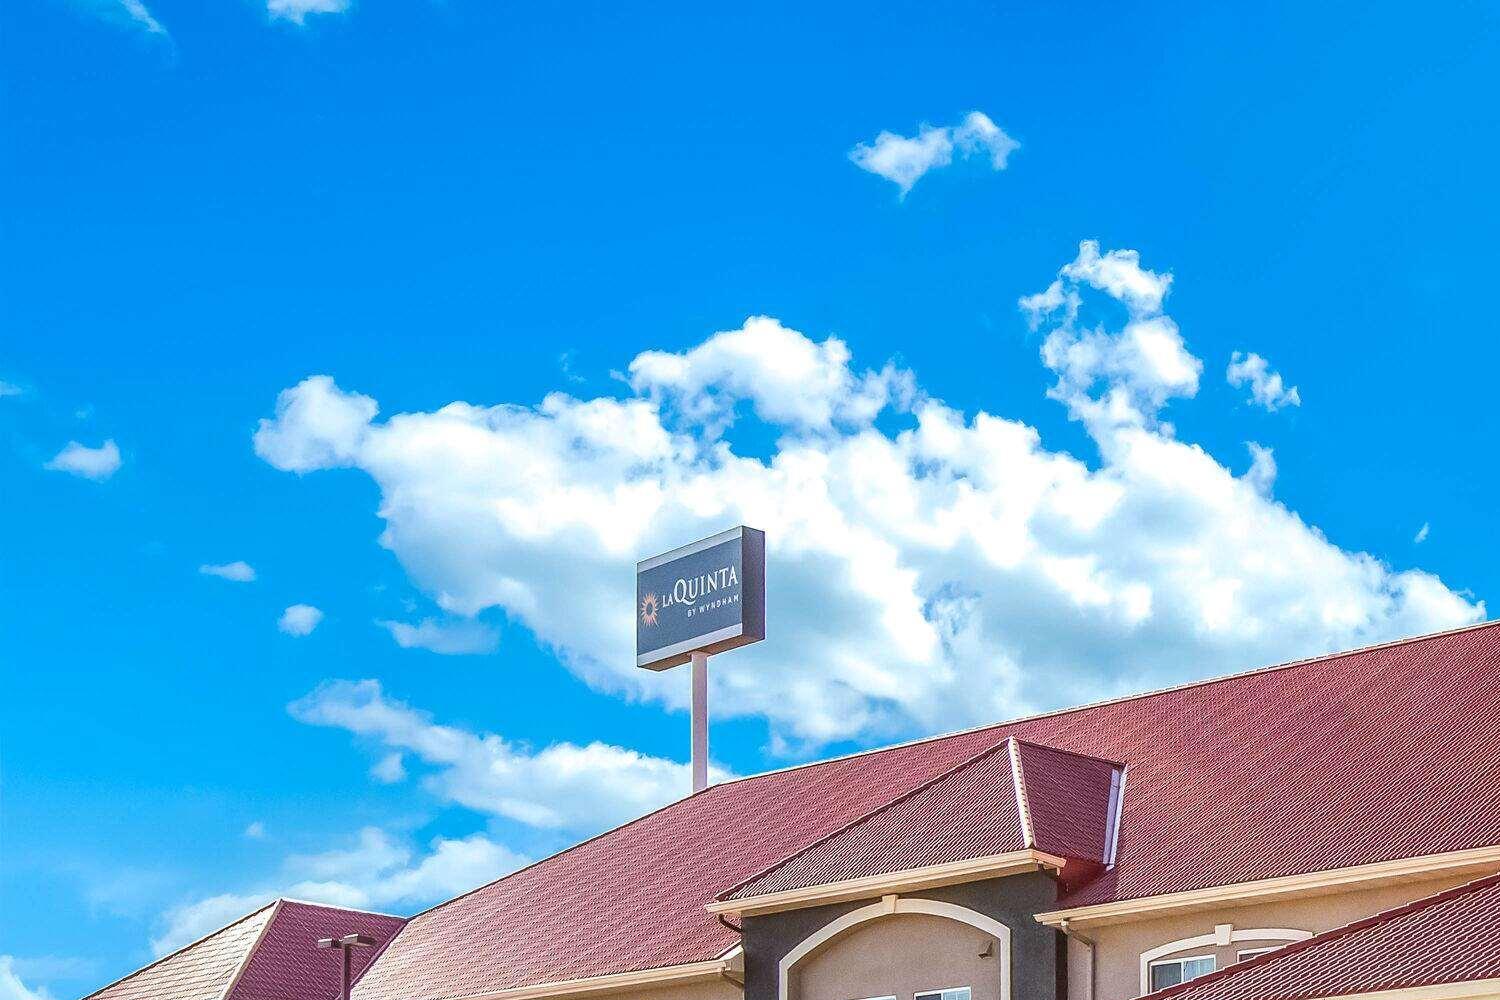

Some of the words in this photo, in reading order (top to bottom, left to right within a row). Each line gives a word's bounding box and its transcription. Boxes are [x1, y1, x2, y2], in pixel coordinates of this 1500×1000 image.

[662, 593, 674, 608] LA
[674, 565, 739, 606] QUINTA
[687, 608, 696, 618] BY
[699, 594, 739, 613] WYNDHAM
